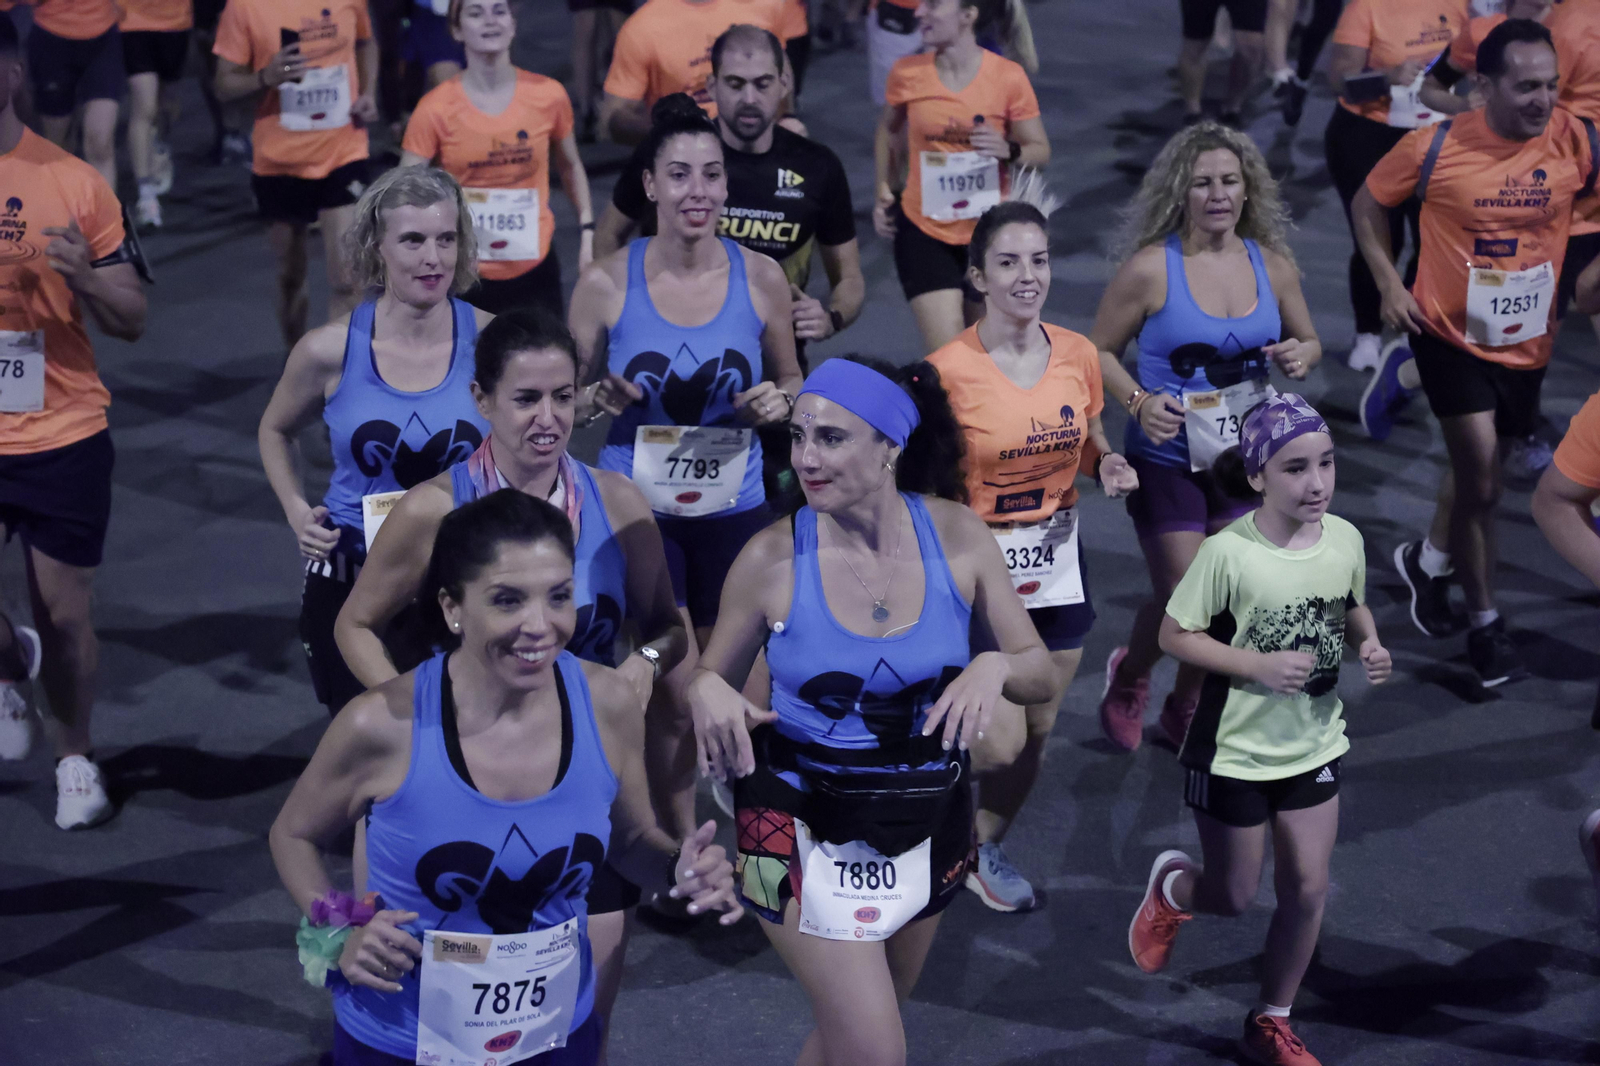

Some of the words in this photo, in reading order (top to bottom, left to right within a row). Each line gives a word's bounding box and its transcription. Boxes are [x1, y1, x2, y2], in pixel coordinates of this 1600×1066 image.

[938, 174, 985, 192] 11970
[1499, 188, 1552, 197] NOCTURNA
[1473, 198, 1521, 207] SEVILLA
[477, 213, 526, 231] 11863
[729, 207, 785, 221] DEPORTIVO
[1490, 292, 1539, 315] 12531
[1216, 415, 1240, 436] 73
[1026, 427, 1082, 445] NOCTURNA
[998, 444, 1051, 460] SEVILLA
[667, 457, 720, 479] 7793
[1006, 544, 1055, 570] 3324
[834, 861, 897, 890] 7880
[880, 893, 903, 901] CRUCES
[535, 944, 560, 956] SEVILLA
[472, 975, 547, 1015] 7875
[464, 1020, 485, 1028] SONIA
[500, 1017, 518, 1026] PILAR
[526, 1012, 541, 1021] SOLA
